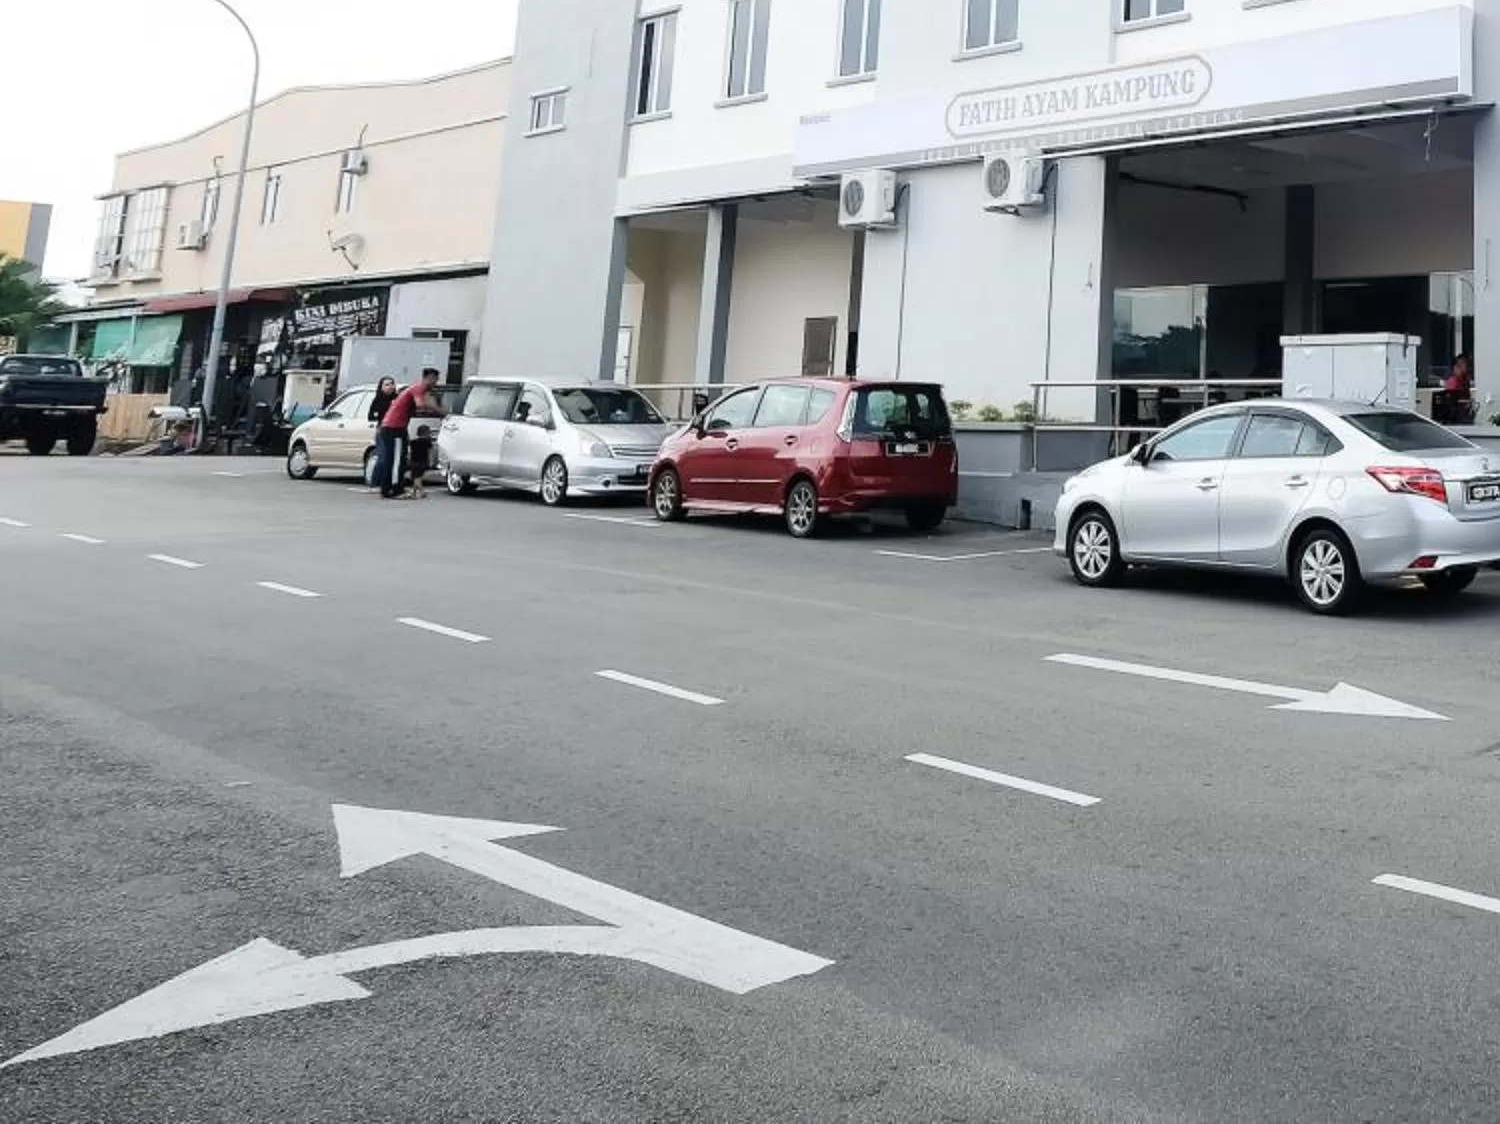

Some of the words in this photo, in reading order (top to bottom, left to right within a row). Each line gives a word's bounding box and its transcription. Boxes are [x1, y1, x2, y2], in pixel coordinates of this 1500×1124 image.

[959, 97, 1016, 127] FATIH
[1022, 85, 1079, 115] AYAM
[1084, 69, 1195, 110] KAMPUNG
[329, 296, 380, 315] DIBUKA
